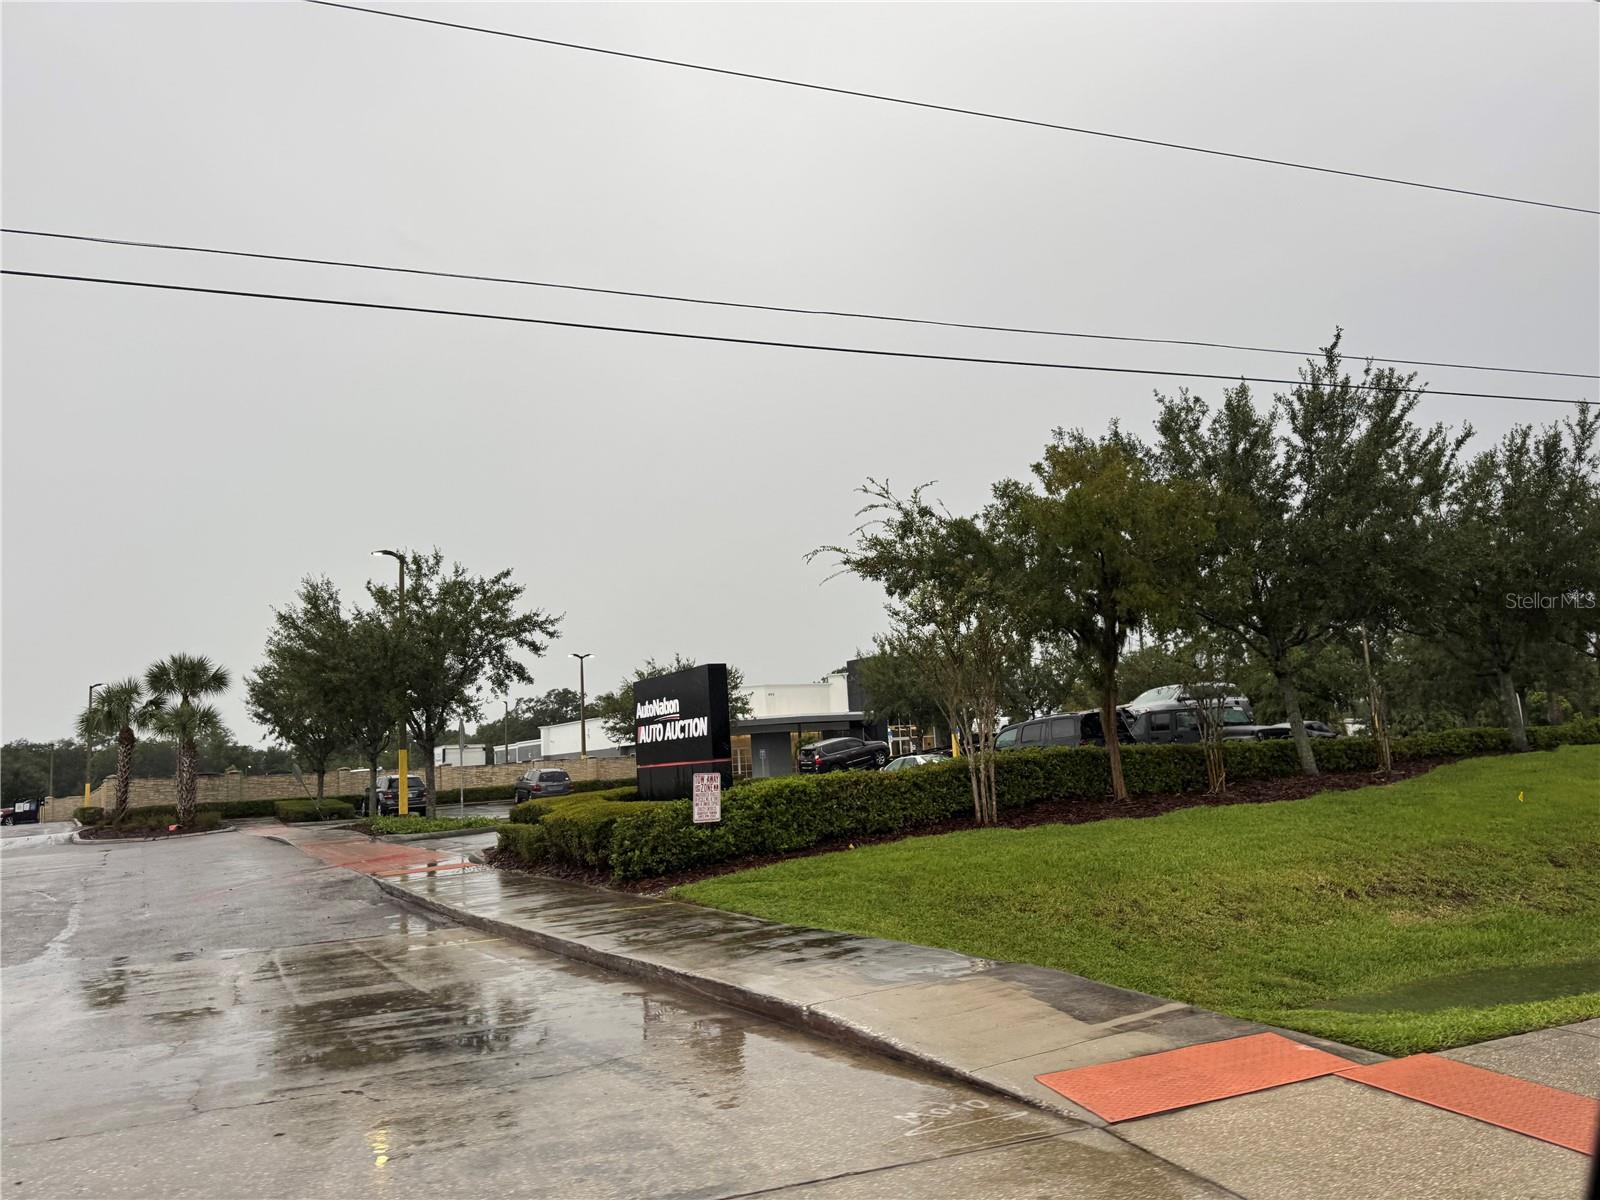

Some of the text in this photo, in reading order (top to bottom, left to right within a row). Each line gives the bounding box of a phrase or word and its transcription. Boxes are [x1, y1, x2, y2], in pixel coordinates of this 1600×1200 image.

[636, 697, 680, 719] AutoNation
[638, 716, 708, 744] AUTO AUCTION
